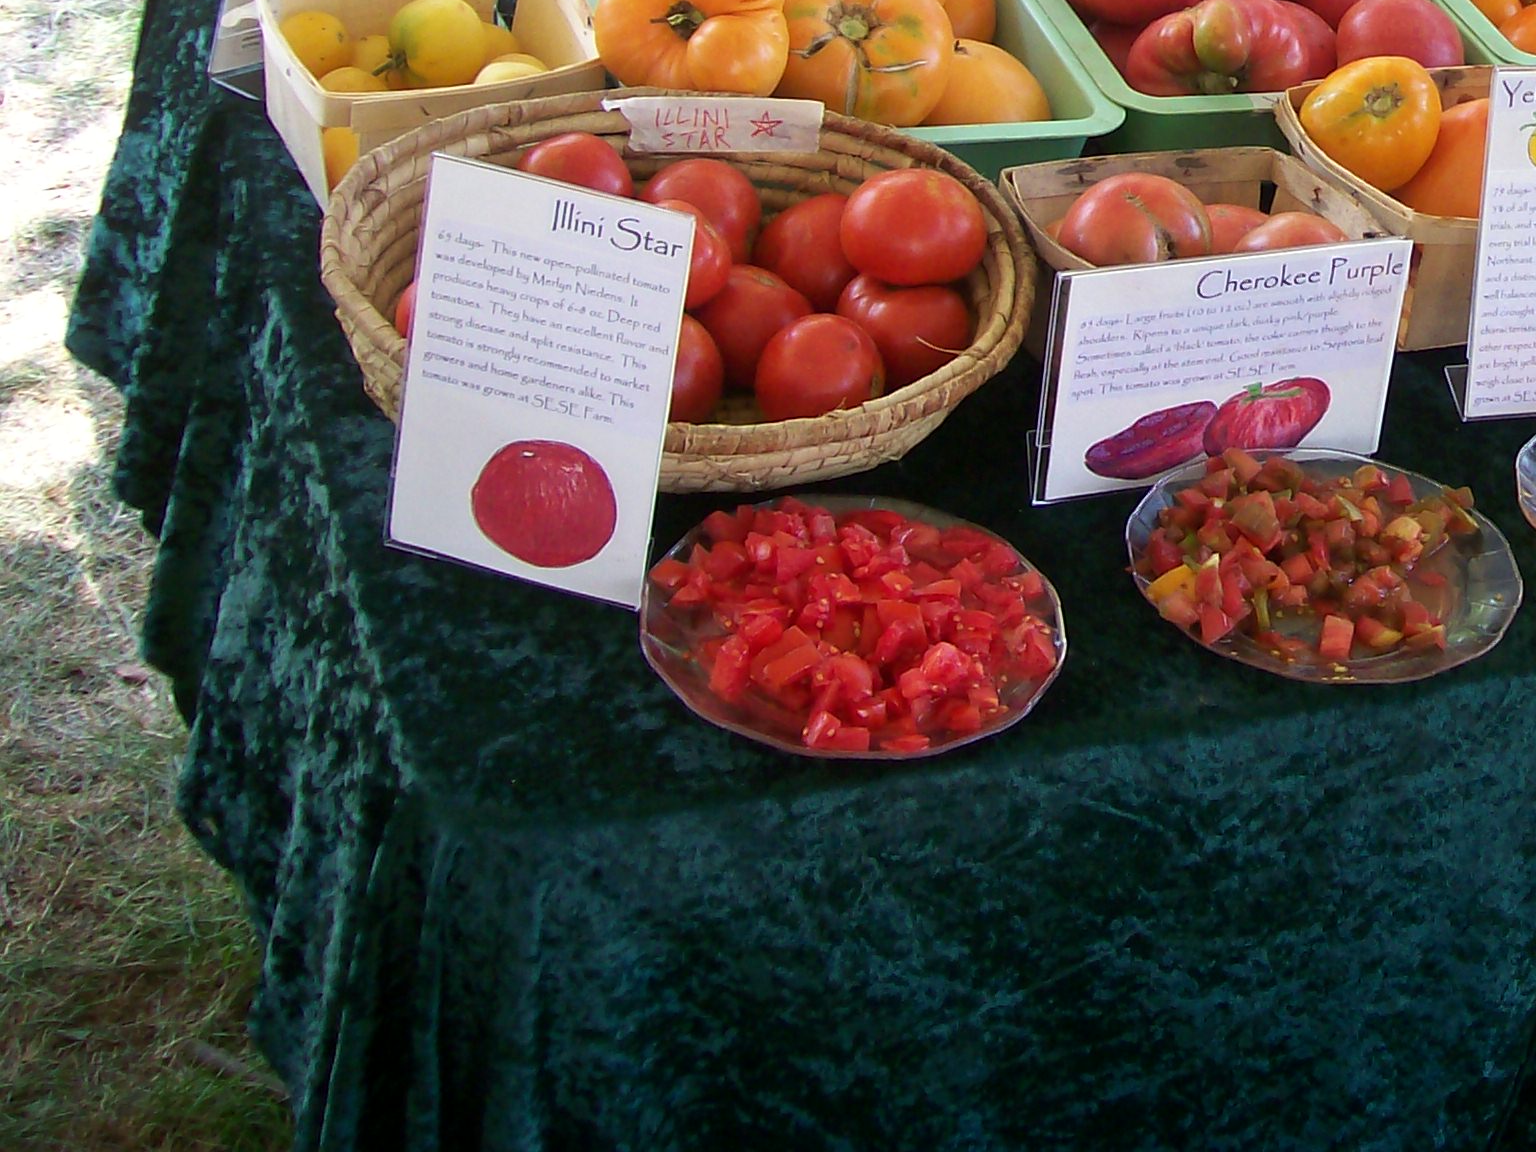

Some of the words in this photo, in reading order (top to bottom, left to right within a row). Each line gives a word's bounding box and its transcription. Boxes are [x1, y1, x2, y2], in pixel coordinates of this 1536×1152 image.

[656, 107, 730, 128] ILLINI
[661, 126, 731, 148] STAR
[552, 200, 603, 239] Illini
[610, 218, 684, 259] Star
[435, 253, 455, 263] was
[457, 254, 515, 277] developed
[516, 267, 530, 285] by
[532, 271, 572, 293] Merlyn
[630, 294, 638, 307] It
[491, 239, 517, 257] This
[520, 252, 541, 262] new
[543, 258, 631, 284] open-pollinated
[632, 277, 670, 294] tomato
[1196, 264, 1322, 299] Cherokee
[1329, 252, 1404, 286] Purple
[432, 272, 484, 289] produces
[486, 279, 517, 302] heavy
[519, 293, 550, 309] crops
[552, 298, 566, 310] of
[607, 309, 640, 331] Deep
[642, 322, 661, 333] red
[489, 300, 520, 323] They
[522, 309, 547, 326] have
[549, 321, 563, 330] an
[565, 325, 614, 342] excellent
[616, 332, 646, 349] flavor
[648, 344, 670, 356] and
[426, 330, 464, 346] tomato
[465, 341, 474, 349] is
[477, 344, 521, 364] strongly
[523, 355, 598, 378] recommended
[600, 372, 612, 382] to
[613, 377, 650, 392] market
[428, 312, 464, 329] strong
[465, 316, 506, 336] disease
[508, 330, 529, 342] and
[530, 335, 554, 350] split
[622, 353, 647, 370] This
[422, 369, 459, 385] tomato
[461, 381, 481, 391] was
[482, 386, 515, 399] grown
[517, 395, 529, 403] at
[531, 394, 579, 417] SESE
[423, 351, 465, 367] growers
[467, 361, 489, 372] and
[490, 362, 519, 380] home
[520, 375, 575, 394] gardeners
[609, 391, 634, 409] This
